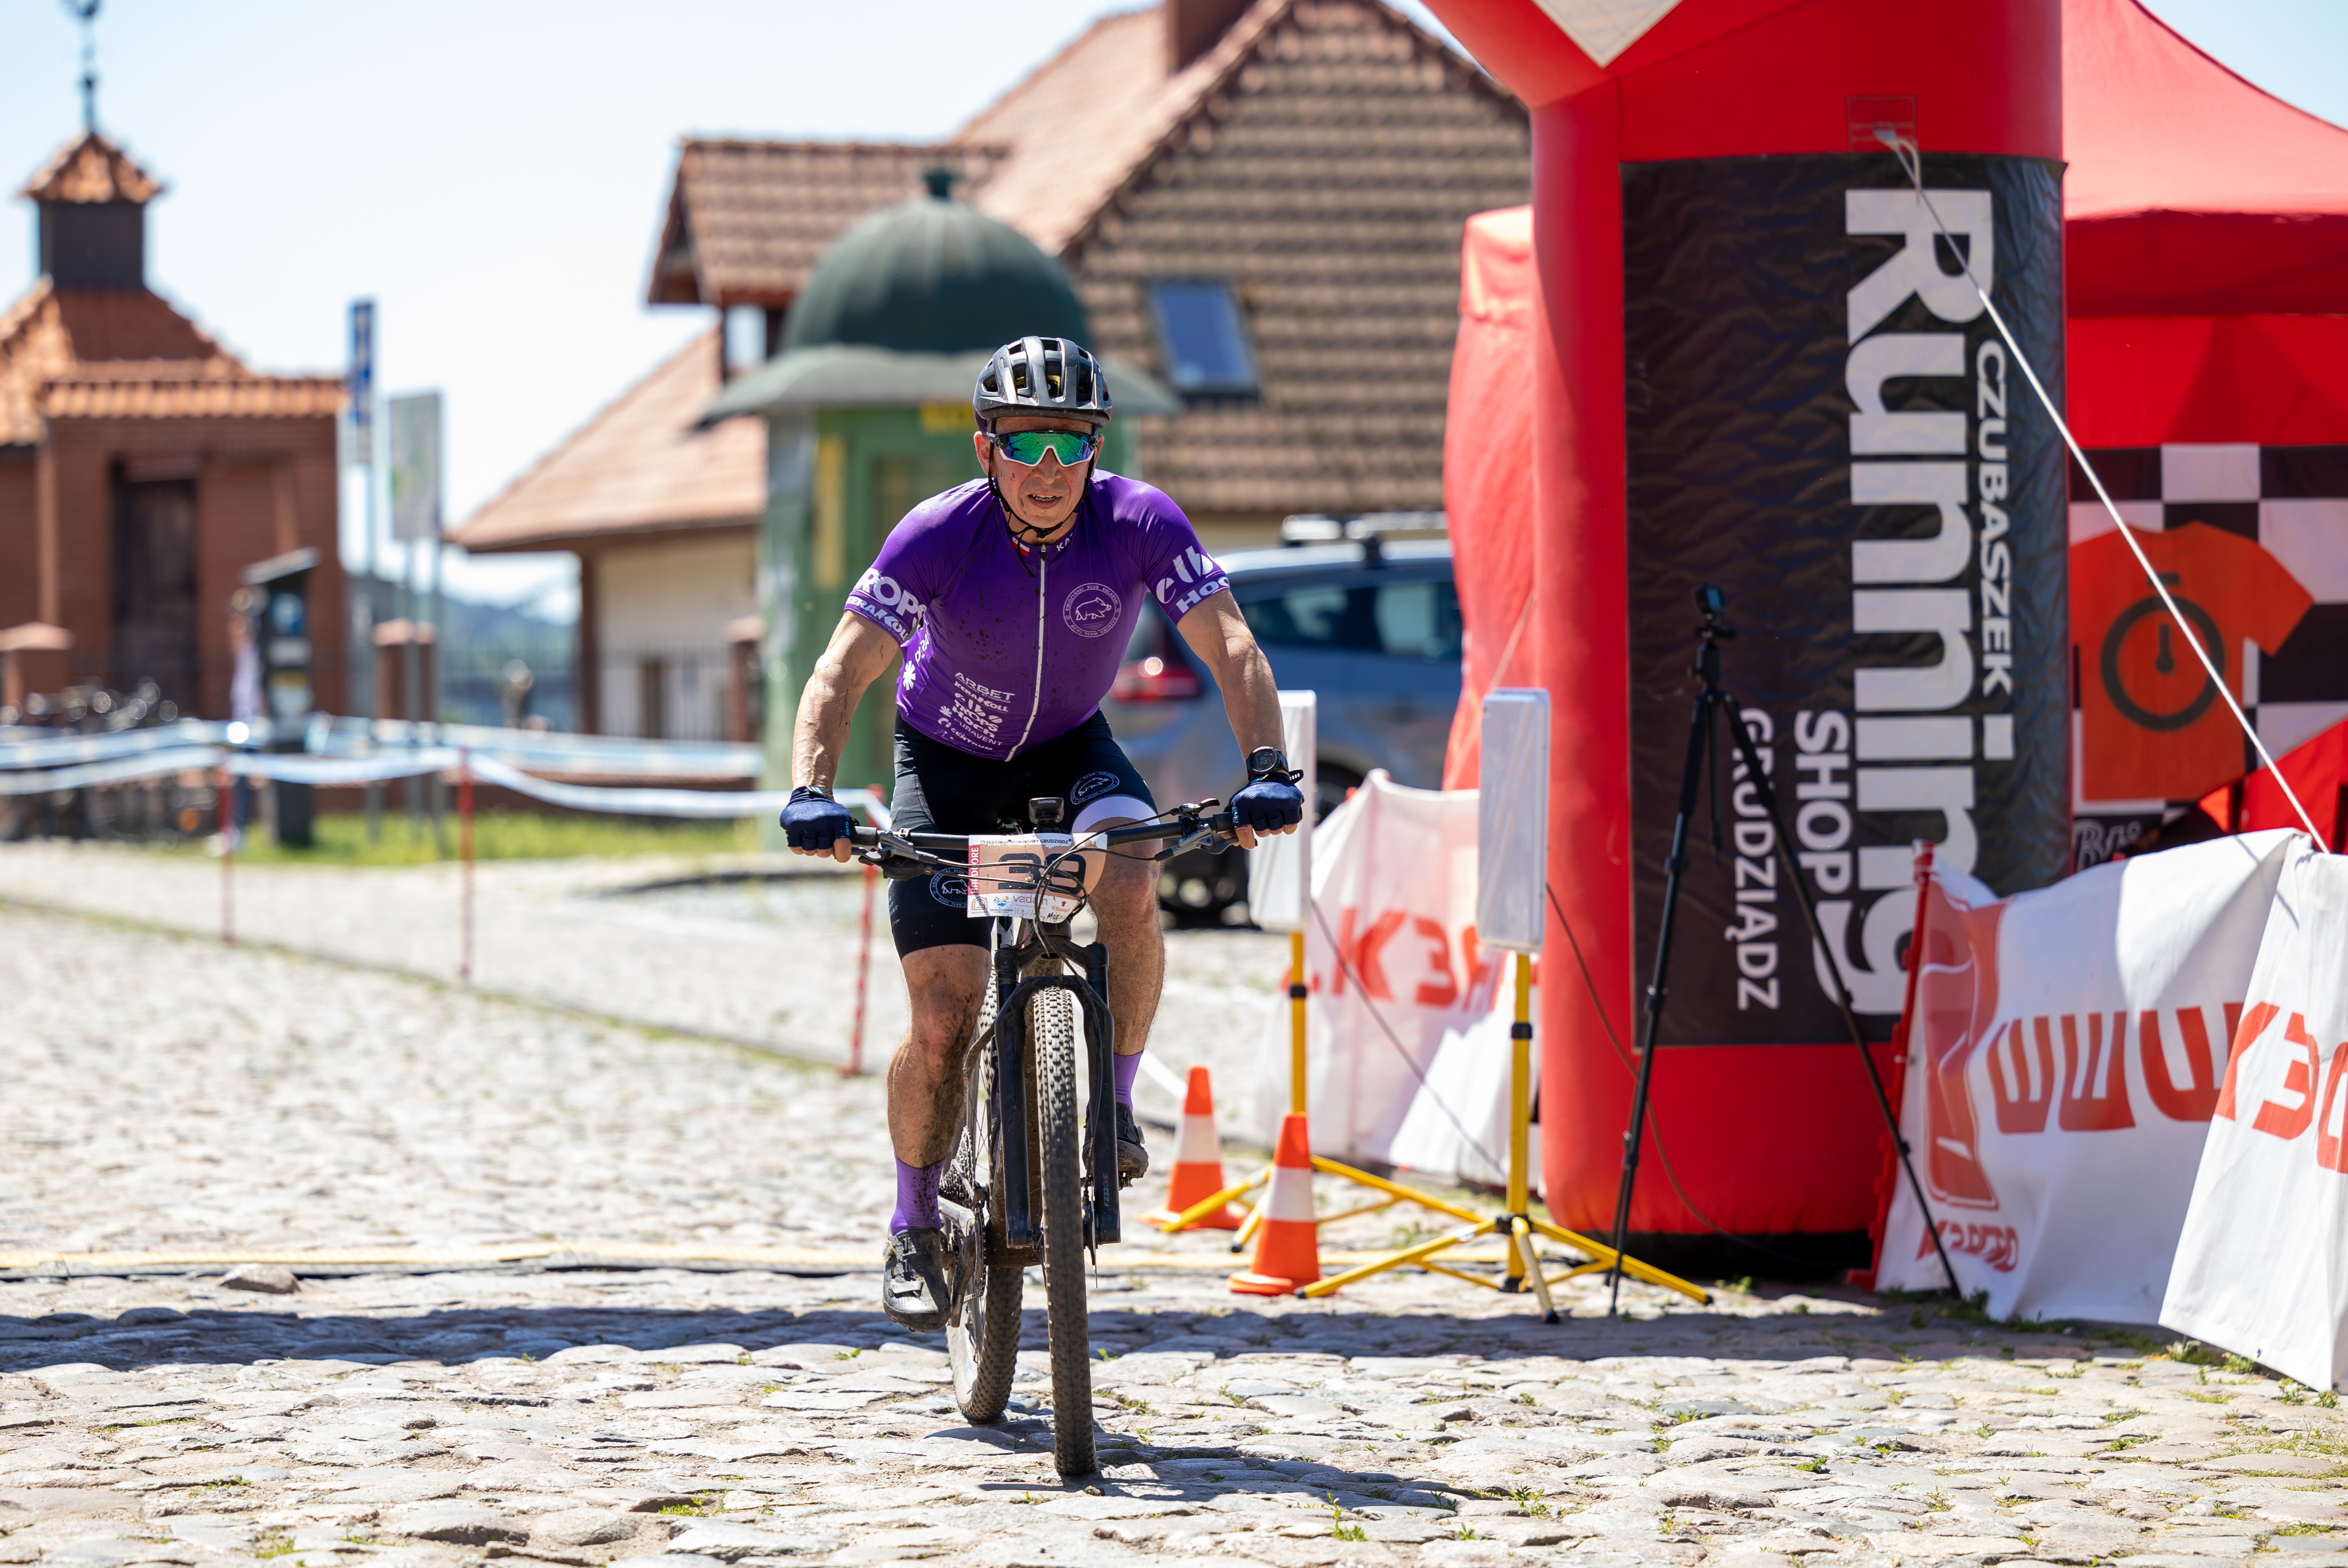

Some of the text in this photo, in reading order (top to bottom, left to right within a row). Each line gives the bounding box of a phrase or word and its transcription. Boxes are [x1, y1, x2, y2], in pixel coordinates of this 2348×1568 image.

[1976, 338, 2013, 698] CZUBASZEK
[1056, 533, 1073, 551] KA
[1156, 545, 1214, 604] elb
[1102, 587, 1119, 604] KOLARSKI
[1812, 189, 2015, 1015] Running
[862, 610, 892, 632] Greenbilding
[1070, 624, 1083, 634] DZIKI
[1100, 617, 1117, 634] KWIDZYN
[954, 681, 1009, 712] KERAKOLL
[955, 672, 1016, 700] ARBET
[982, 692, 1011, 704] STYROPIAN
[954, 699, 999, 732] TROPS
[1794, 709, 1853, 894] SHOP
[1724, 707, 1781, 1011] GRUDZIĄDZ
[1013, 895, 1048, 905] vadn
